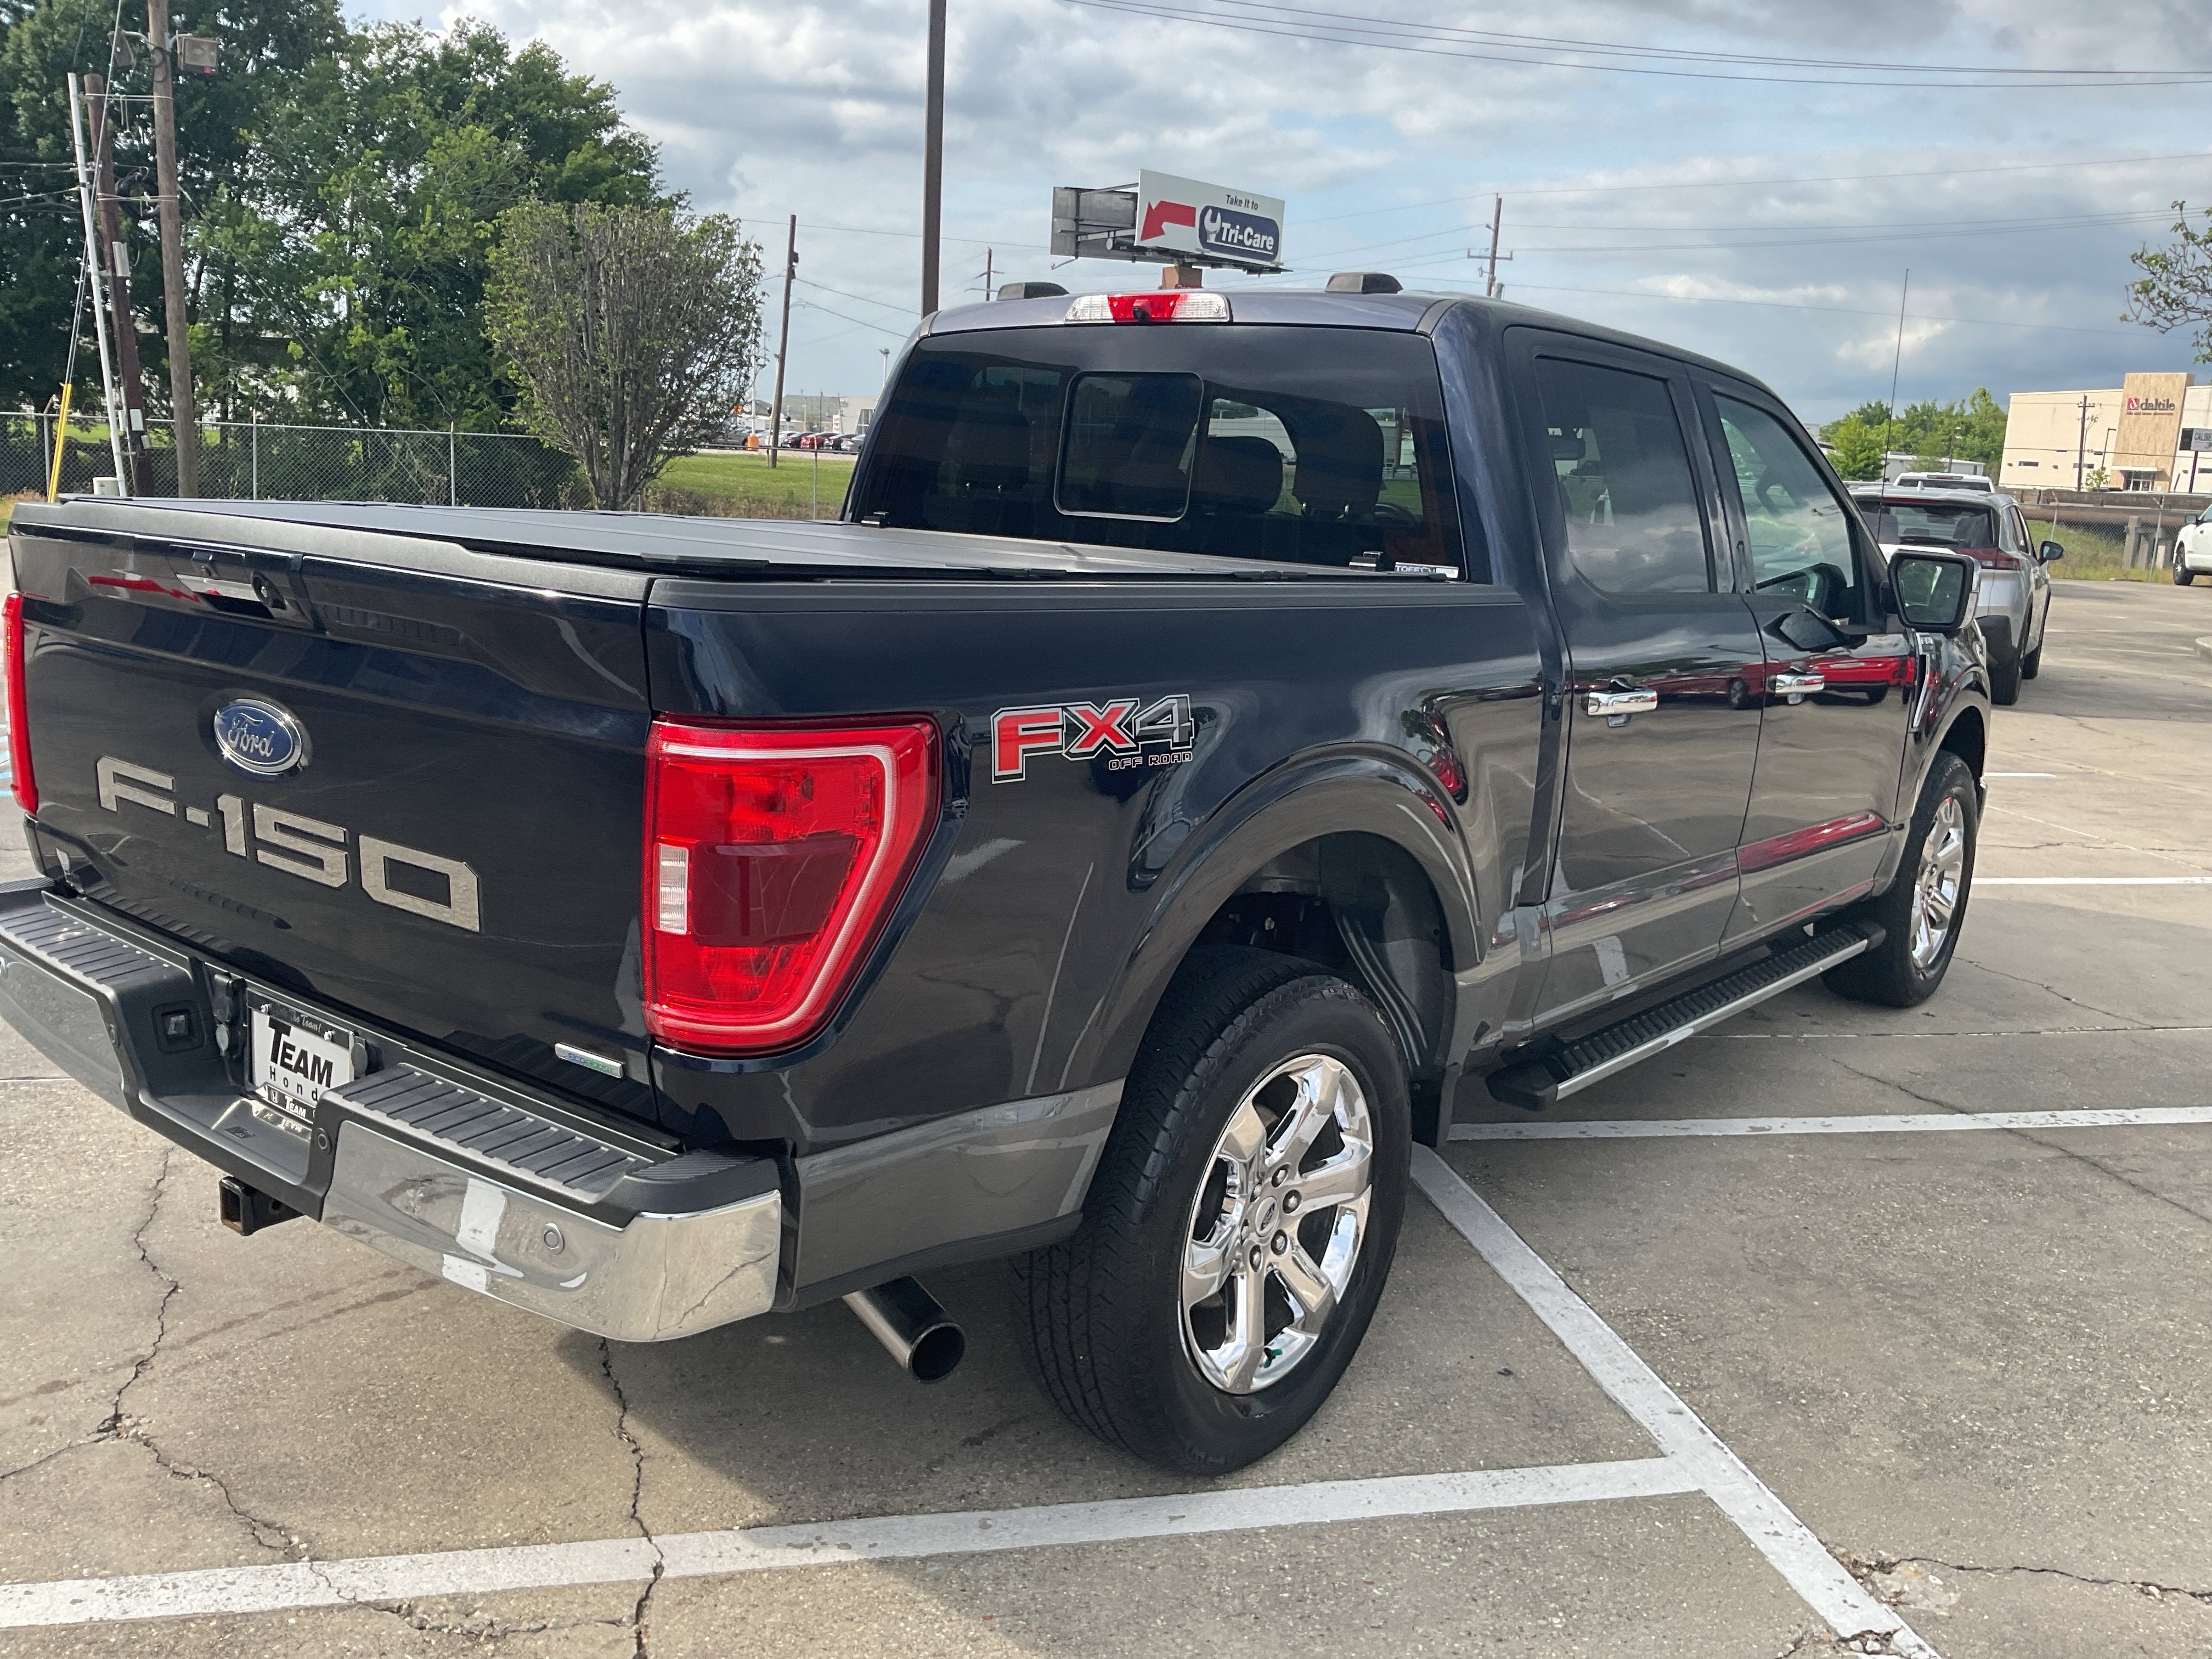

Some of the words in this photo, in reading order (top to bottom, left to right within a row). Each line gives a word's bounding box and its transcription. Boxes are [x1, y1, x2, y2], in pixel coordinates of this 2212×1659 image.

[1226, 194, 1243, 207] Take
[1244, 199, 1249, 208] It
[1251, 200, 1259, 210] to
[1221, 222, 1274, 250] Tri-Care
[2140, 398, 2175, 410] daltile
[227, 712, 275, 758] Ford
[990, 694, 1194, 785] FX4
[1108, 757, 1143, 770] OFF
[1148, 751, 1193, 766] ROAD
[96, 755, 481, 933] F-150
[268, 1016, 334, 1088] TEAM
[269, 1065, 318, 1102] Hond
[285, 1095, 306, 1119] TEAM
